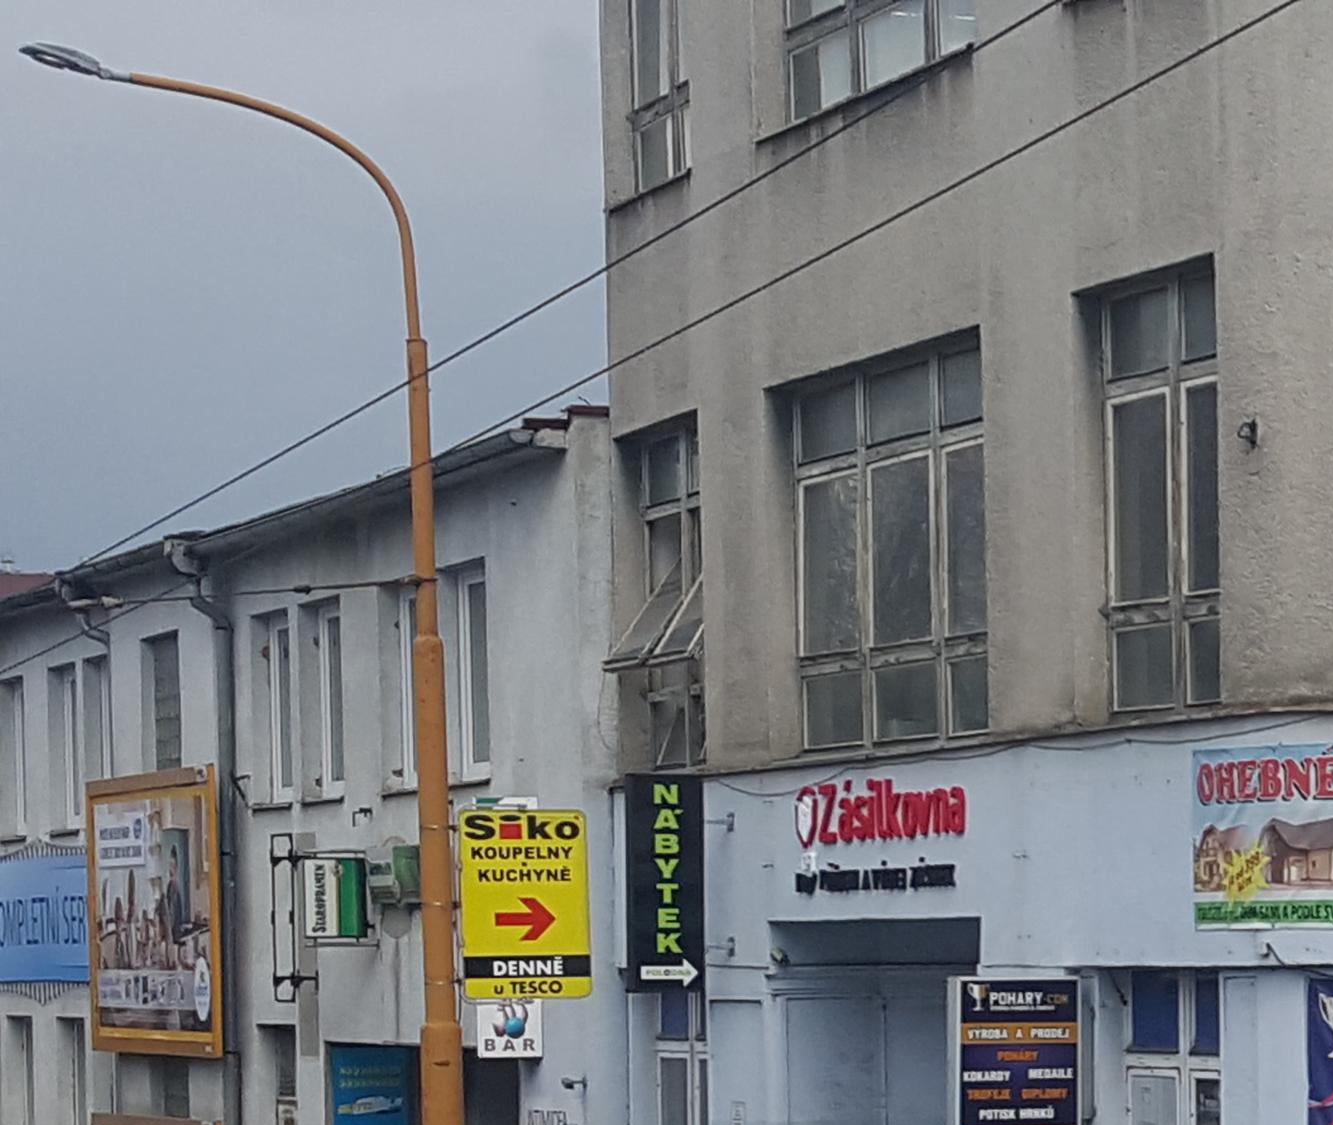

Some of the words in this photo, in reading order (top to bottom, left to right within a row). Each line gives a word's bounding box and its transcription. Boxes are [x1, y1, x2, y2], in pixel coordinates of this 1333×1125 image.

[817, 778, 966, 844] Zásilkovna
[471, 846, 573, 860] KOUPELNY
[478, 866, 572, 882] KUCHYNĚ
[653, 784, 683, 954] NÁBYTEK
[493, 956, 564, 976] DENNĚ
[510, 980, 563, 994] TESCO
[484, 1037, 535, 1052] BAR
